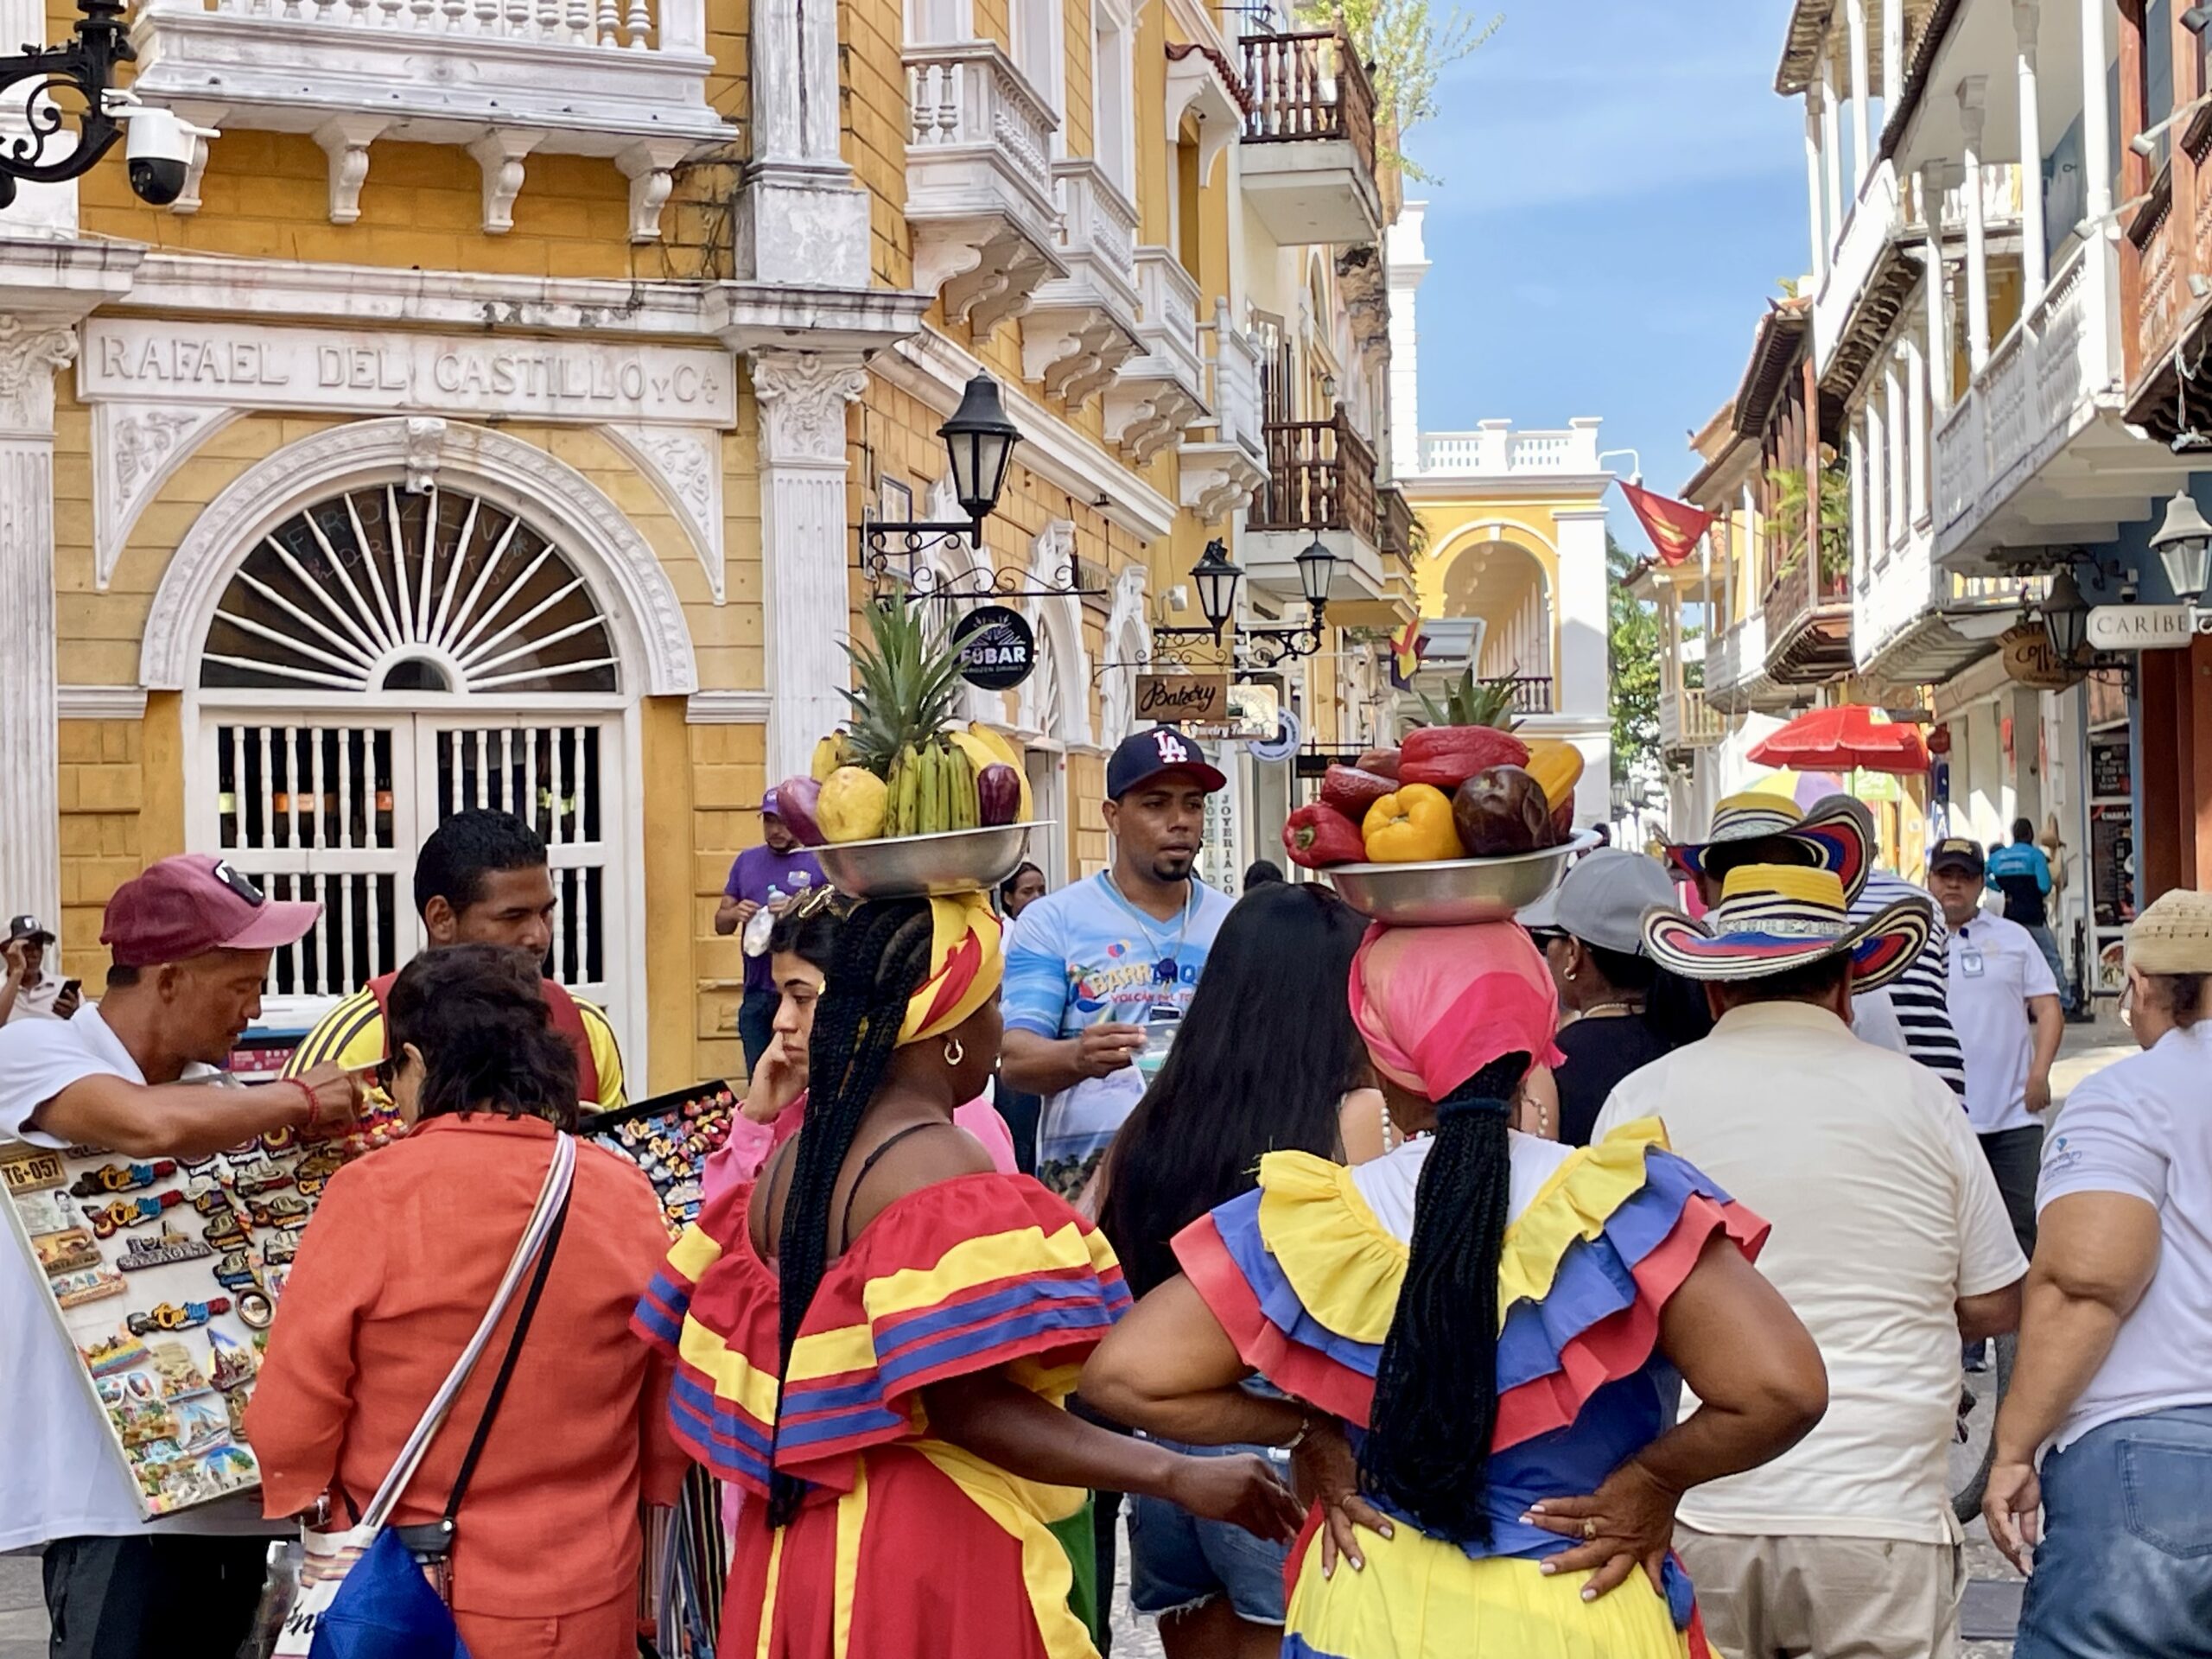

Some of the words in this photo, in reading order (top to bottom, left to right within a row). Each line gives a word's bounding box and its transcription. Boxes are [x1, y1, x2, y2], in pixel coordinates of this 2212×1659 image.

[100, 335, 289, 385] RAFAEL
[318, 345, 407, 390] DEL
[434, 354, 647, 401] CASTILLO
[1141, 680, 1216, 713] Bakery
[1154, 730, 1187, 764] LA
